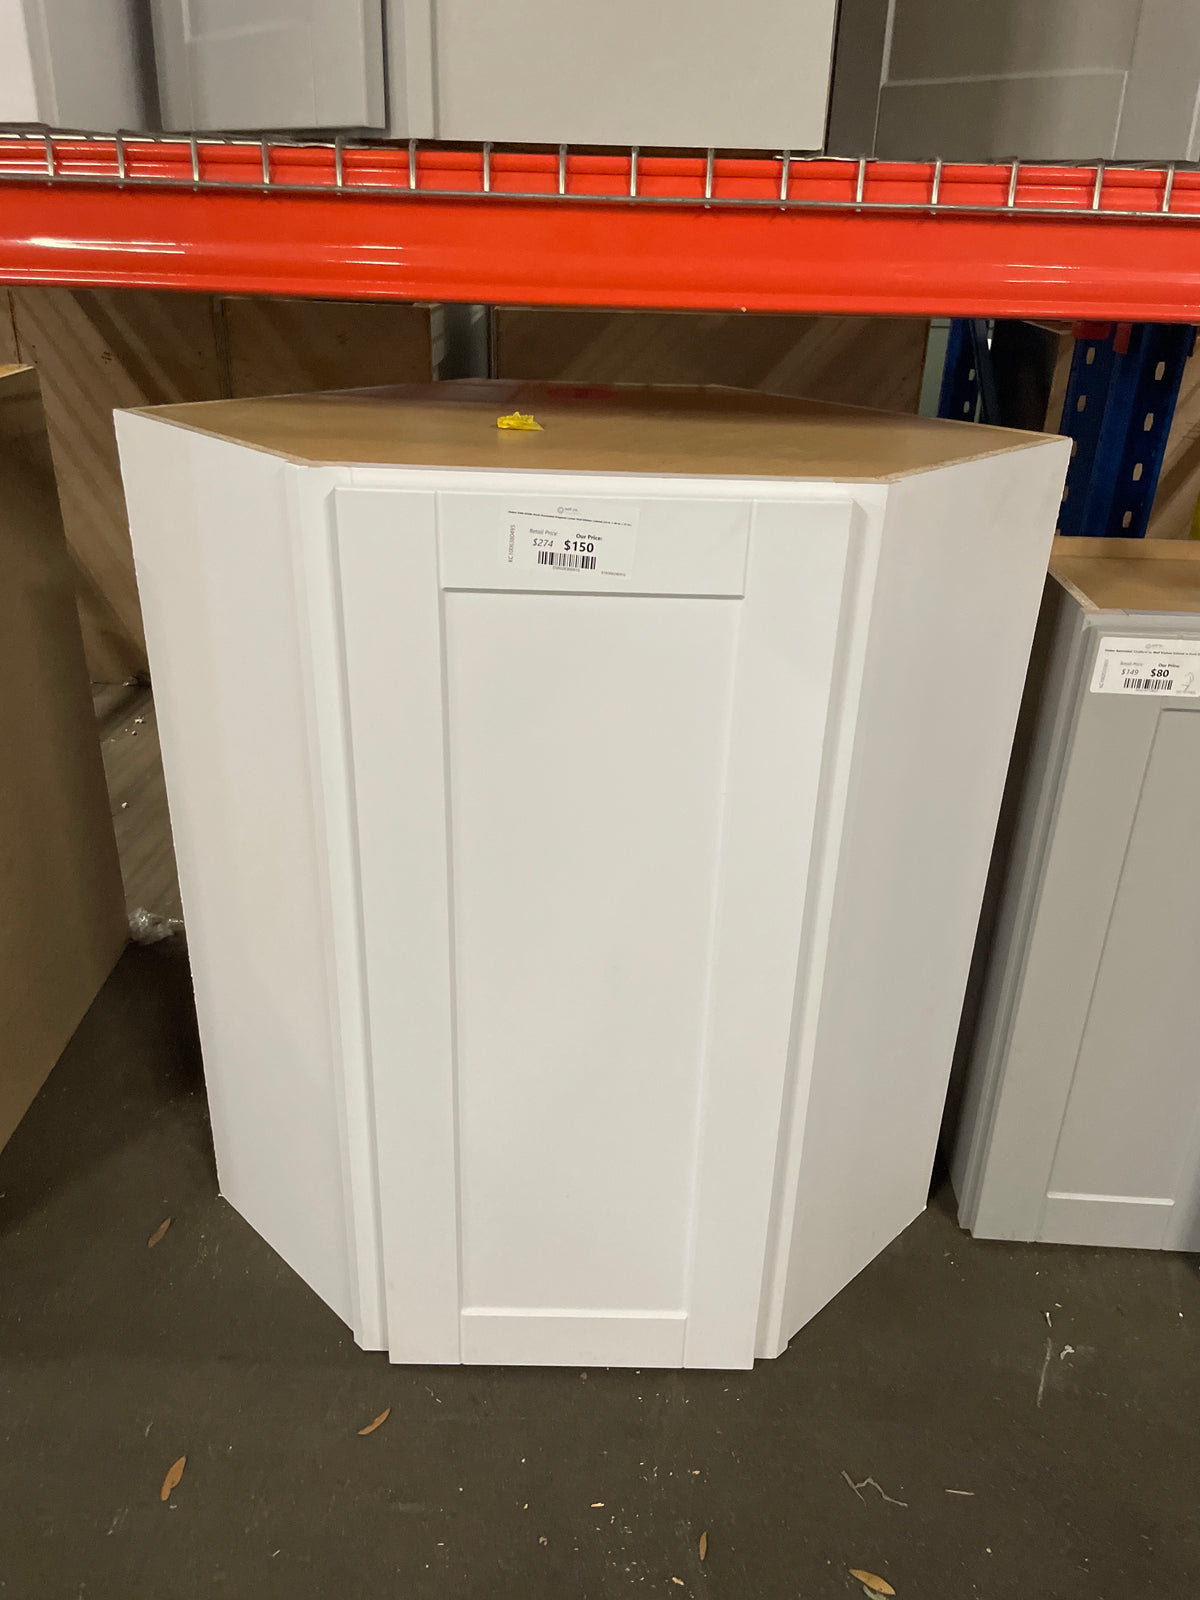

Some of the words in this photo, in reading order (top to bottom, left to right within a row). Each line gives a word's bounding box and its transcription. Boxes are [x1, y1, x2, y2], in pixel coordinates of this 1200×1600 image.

[532, 538, 554, 548] $274
[564, 539, 594, 553] $150
[1121, 668, 1139, 676] $149
[1150, 668, 1170, 678] $80
